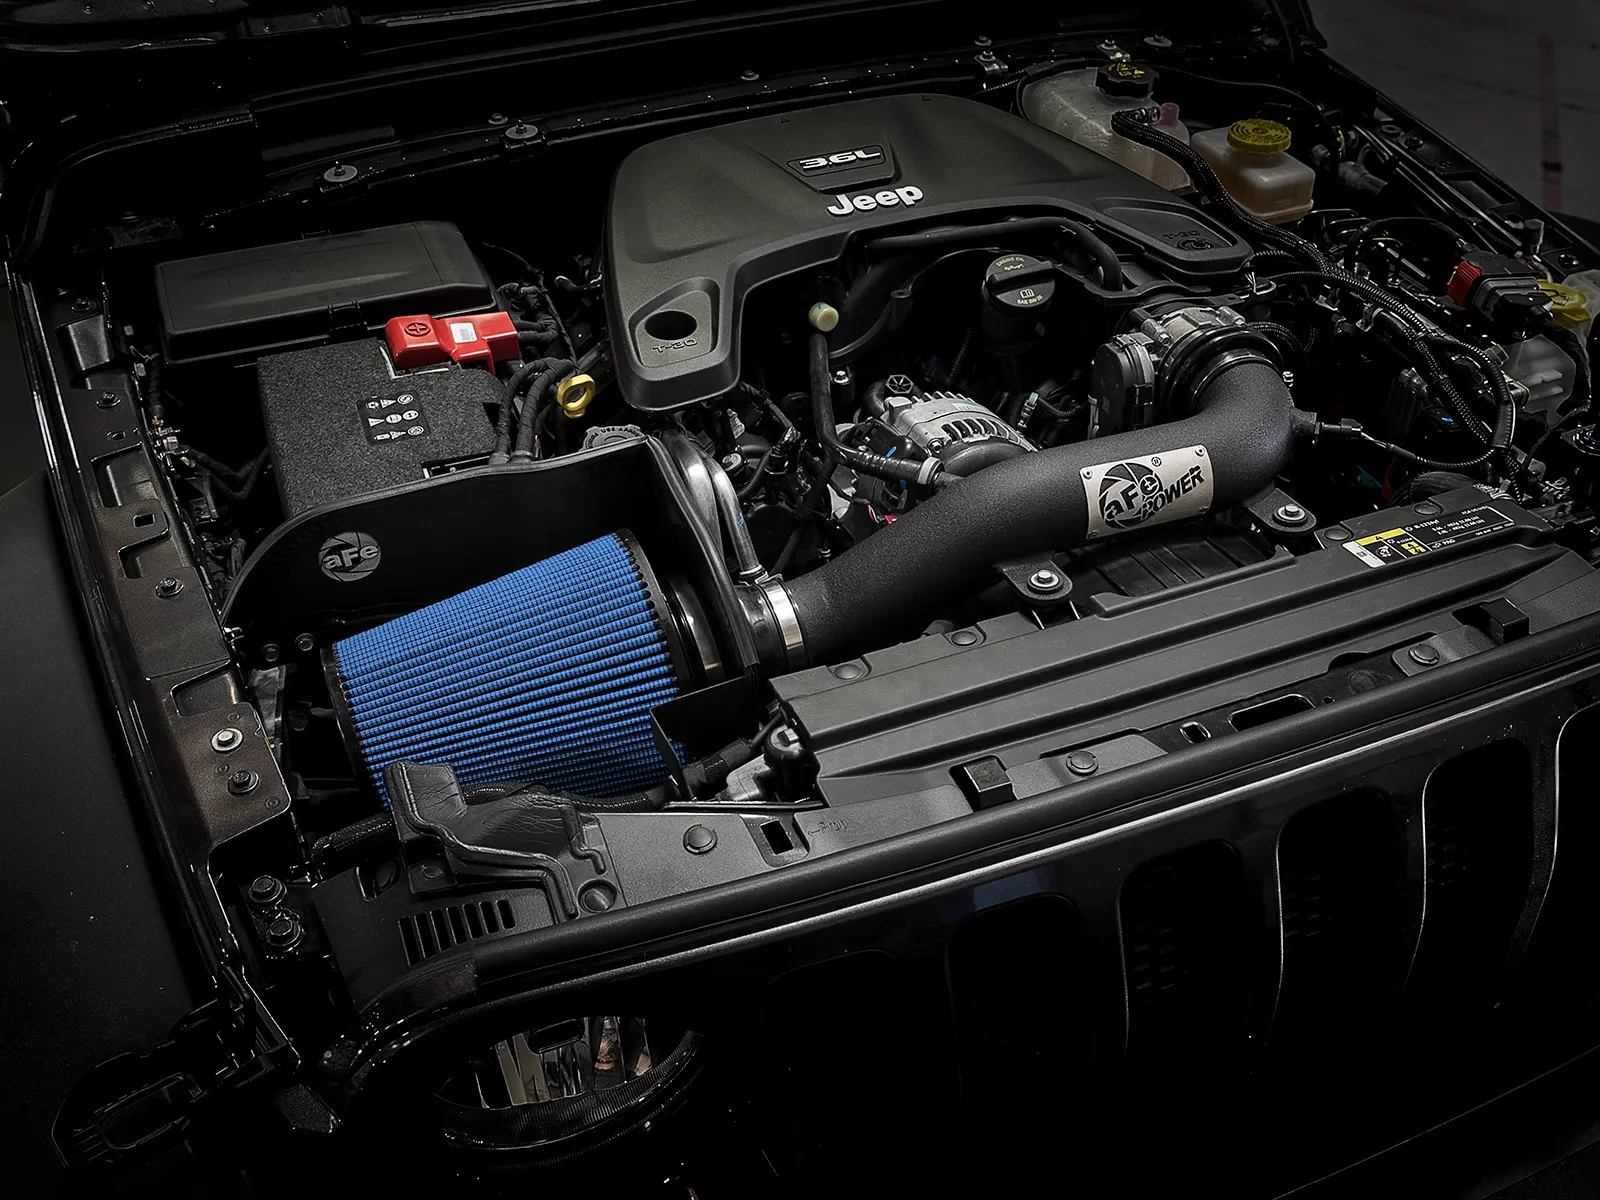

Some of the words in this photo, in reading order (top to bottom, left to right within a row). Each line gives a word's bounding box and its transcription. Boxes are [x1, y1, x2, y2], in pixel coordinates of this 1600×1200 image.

[800, 149, 881, 171] 3.6L
[827, 185, 924, 216] Jeep
[1140, 465, 1205, 521] POWER
[322, 545, 379, 570] aFe
